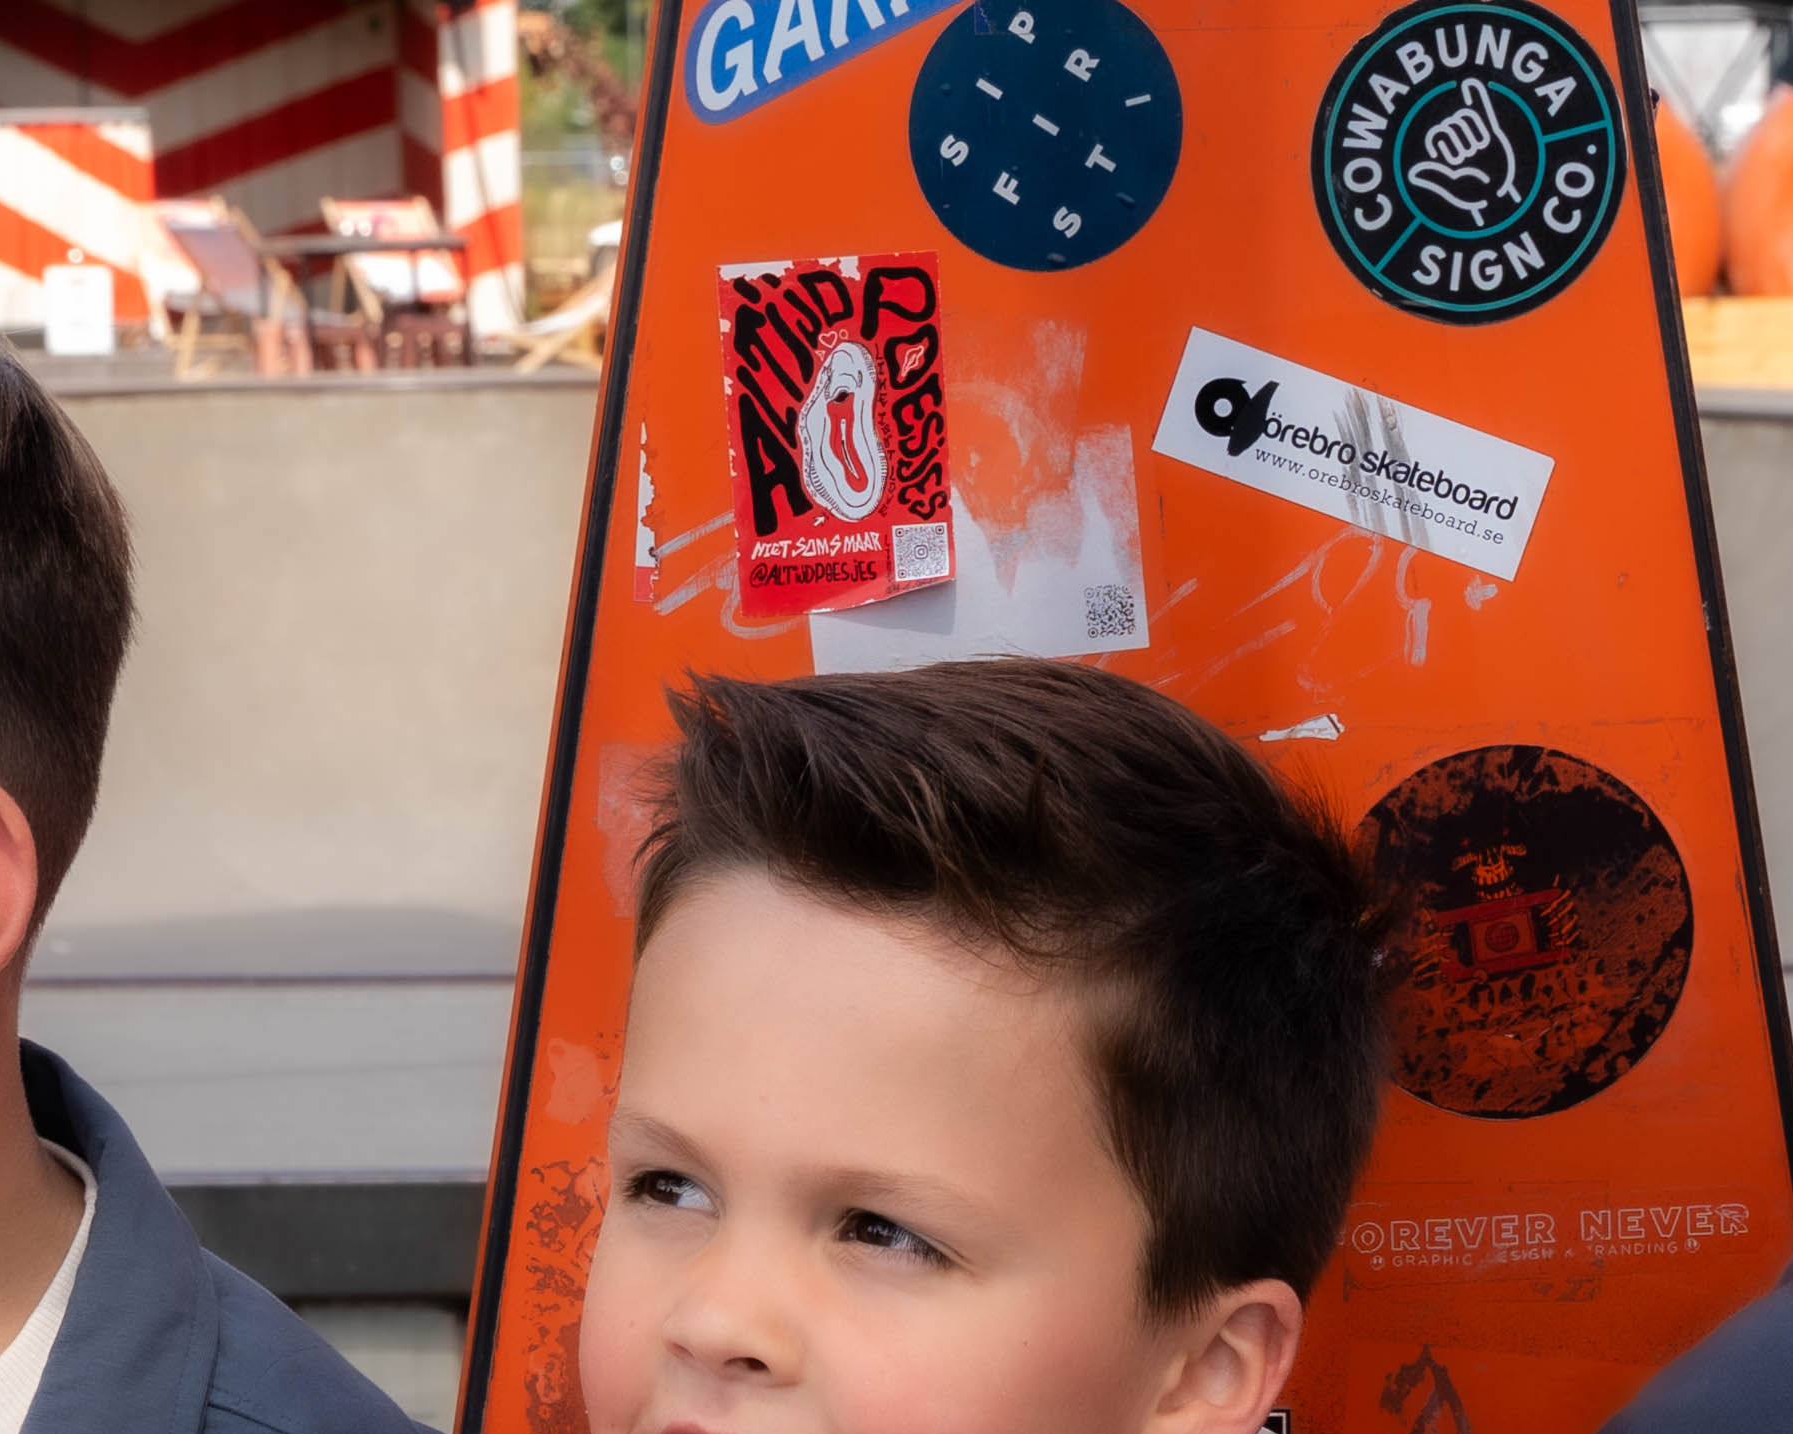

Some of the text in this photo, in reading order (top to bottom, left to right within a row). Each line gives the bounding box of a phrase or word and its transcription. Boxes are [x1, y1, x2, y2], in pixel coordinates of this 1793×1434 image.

[1342, 24, 1578, 231] COWABUNGA
[1412, 143, 1597, 292] SIGN CO.
[1254, 447, 1505, 546] www.orebroskateboard.se
[1263, 413, 1519, 521] örebro skateboard
[751, 540, 792, 560] NIET
[843, 532, 882, 554] MAAR
[1338, 1203, 1750, 1253] OREVER NEVER
[1393, 1254, 1474, 1267] GRAPHIC
